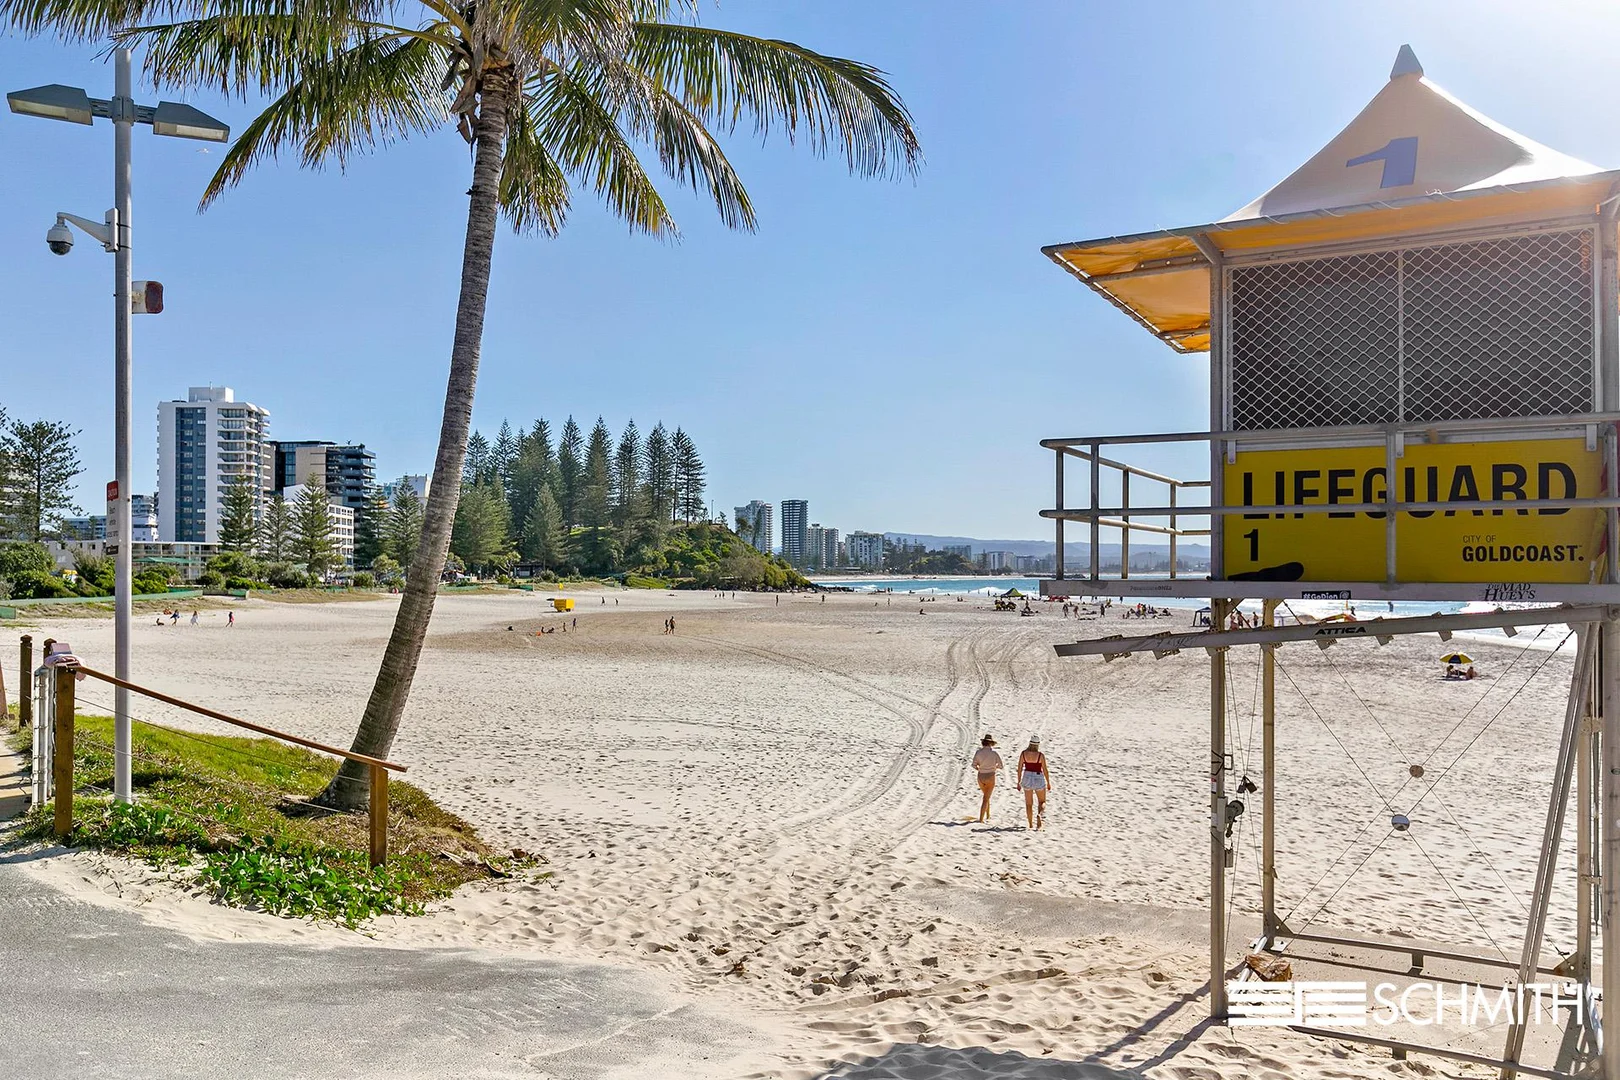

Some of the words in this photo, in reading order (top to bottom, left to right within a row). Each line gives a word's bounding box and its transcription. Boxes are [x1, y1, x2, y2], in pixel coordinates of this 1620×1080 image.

[1346, 136, 1418, 189] 1
[1243, 462, 1577, 519] LIFEGUARD
[1243, 528, 1259, 562] 1
[1462, 535, 1481, 544] CITY
[1485, 534, 1496, 543] OF
[1484, 588, 1536, 601] HUEY'S
[1315, 627, 1366, 636] ATTICA
